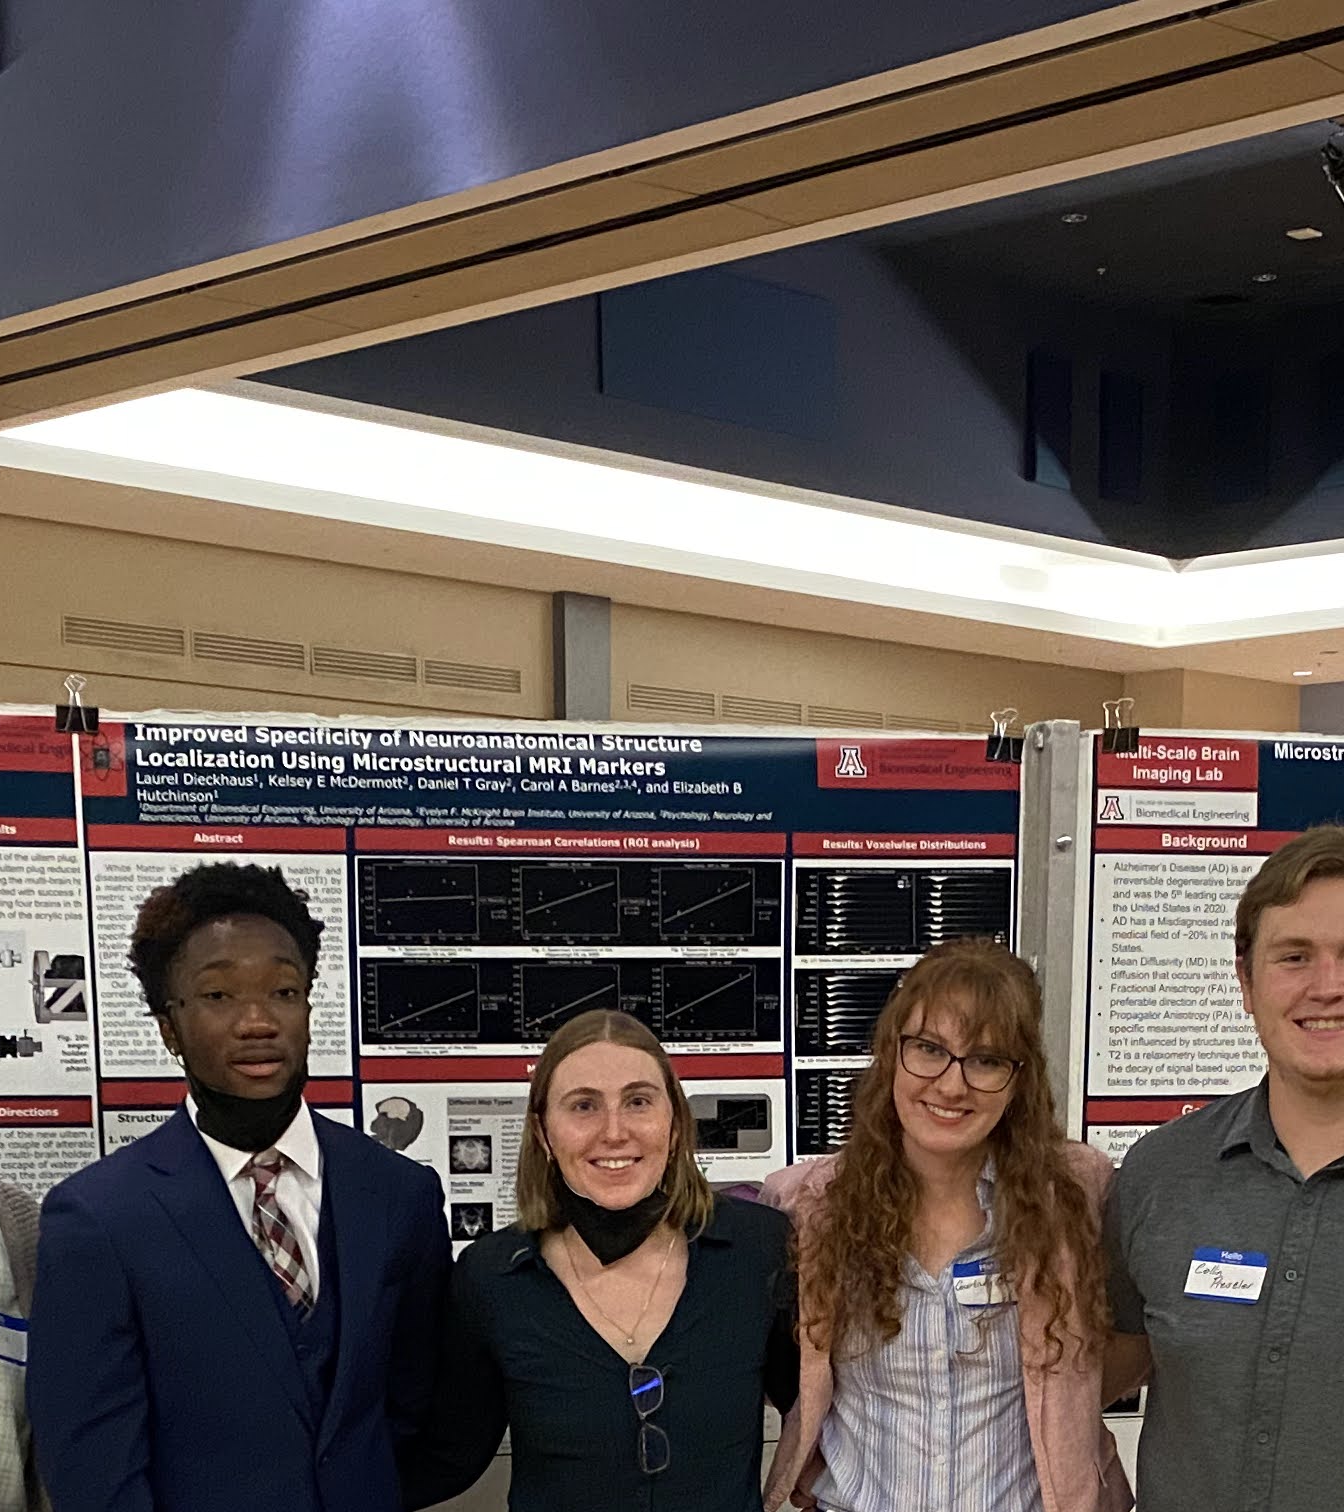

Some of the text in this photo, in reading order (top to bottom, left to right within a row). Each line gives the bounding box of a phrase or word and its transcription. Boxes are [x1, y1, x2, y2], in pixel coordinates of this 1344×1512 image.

[134, 725, 702, 753] Improved Specificity of Neuroanatomical Structure
[1201, 746, 1239, 761] Brain
[136, 748, 665, 776] Localization Using Microstructural MRI Markers
[1133, 765, 1223, 784] Imaging Lab
[136, 772, 178, 785] Laurel
[268, 774, 312, 789] Kelsey
[317, 775, 326, 788] E
[418, 777, 459, 790] Daniel
[462, 778, 471, 789] T
[521, 778, 554, 791] Carol
[558, 780, 568, 792] A
[646, 781, 669, 793] and
[673, 781, 729, 794] Elizabeth
[733, 782, 742, 794] B
[1136, 807, 1250, 823] Biomedical Engineering
[194, 833, 243, 843] Abstract
[448, 835, 700, 850] Results: Spearman Correlations (ROI analysis)
[823, 839, 986, 850] Results: Voxelwise Distributions
[1162, 833, 1247, 850] Background
